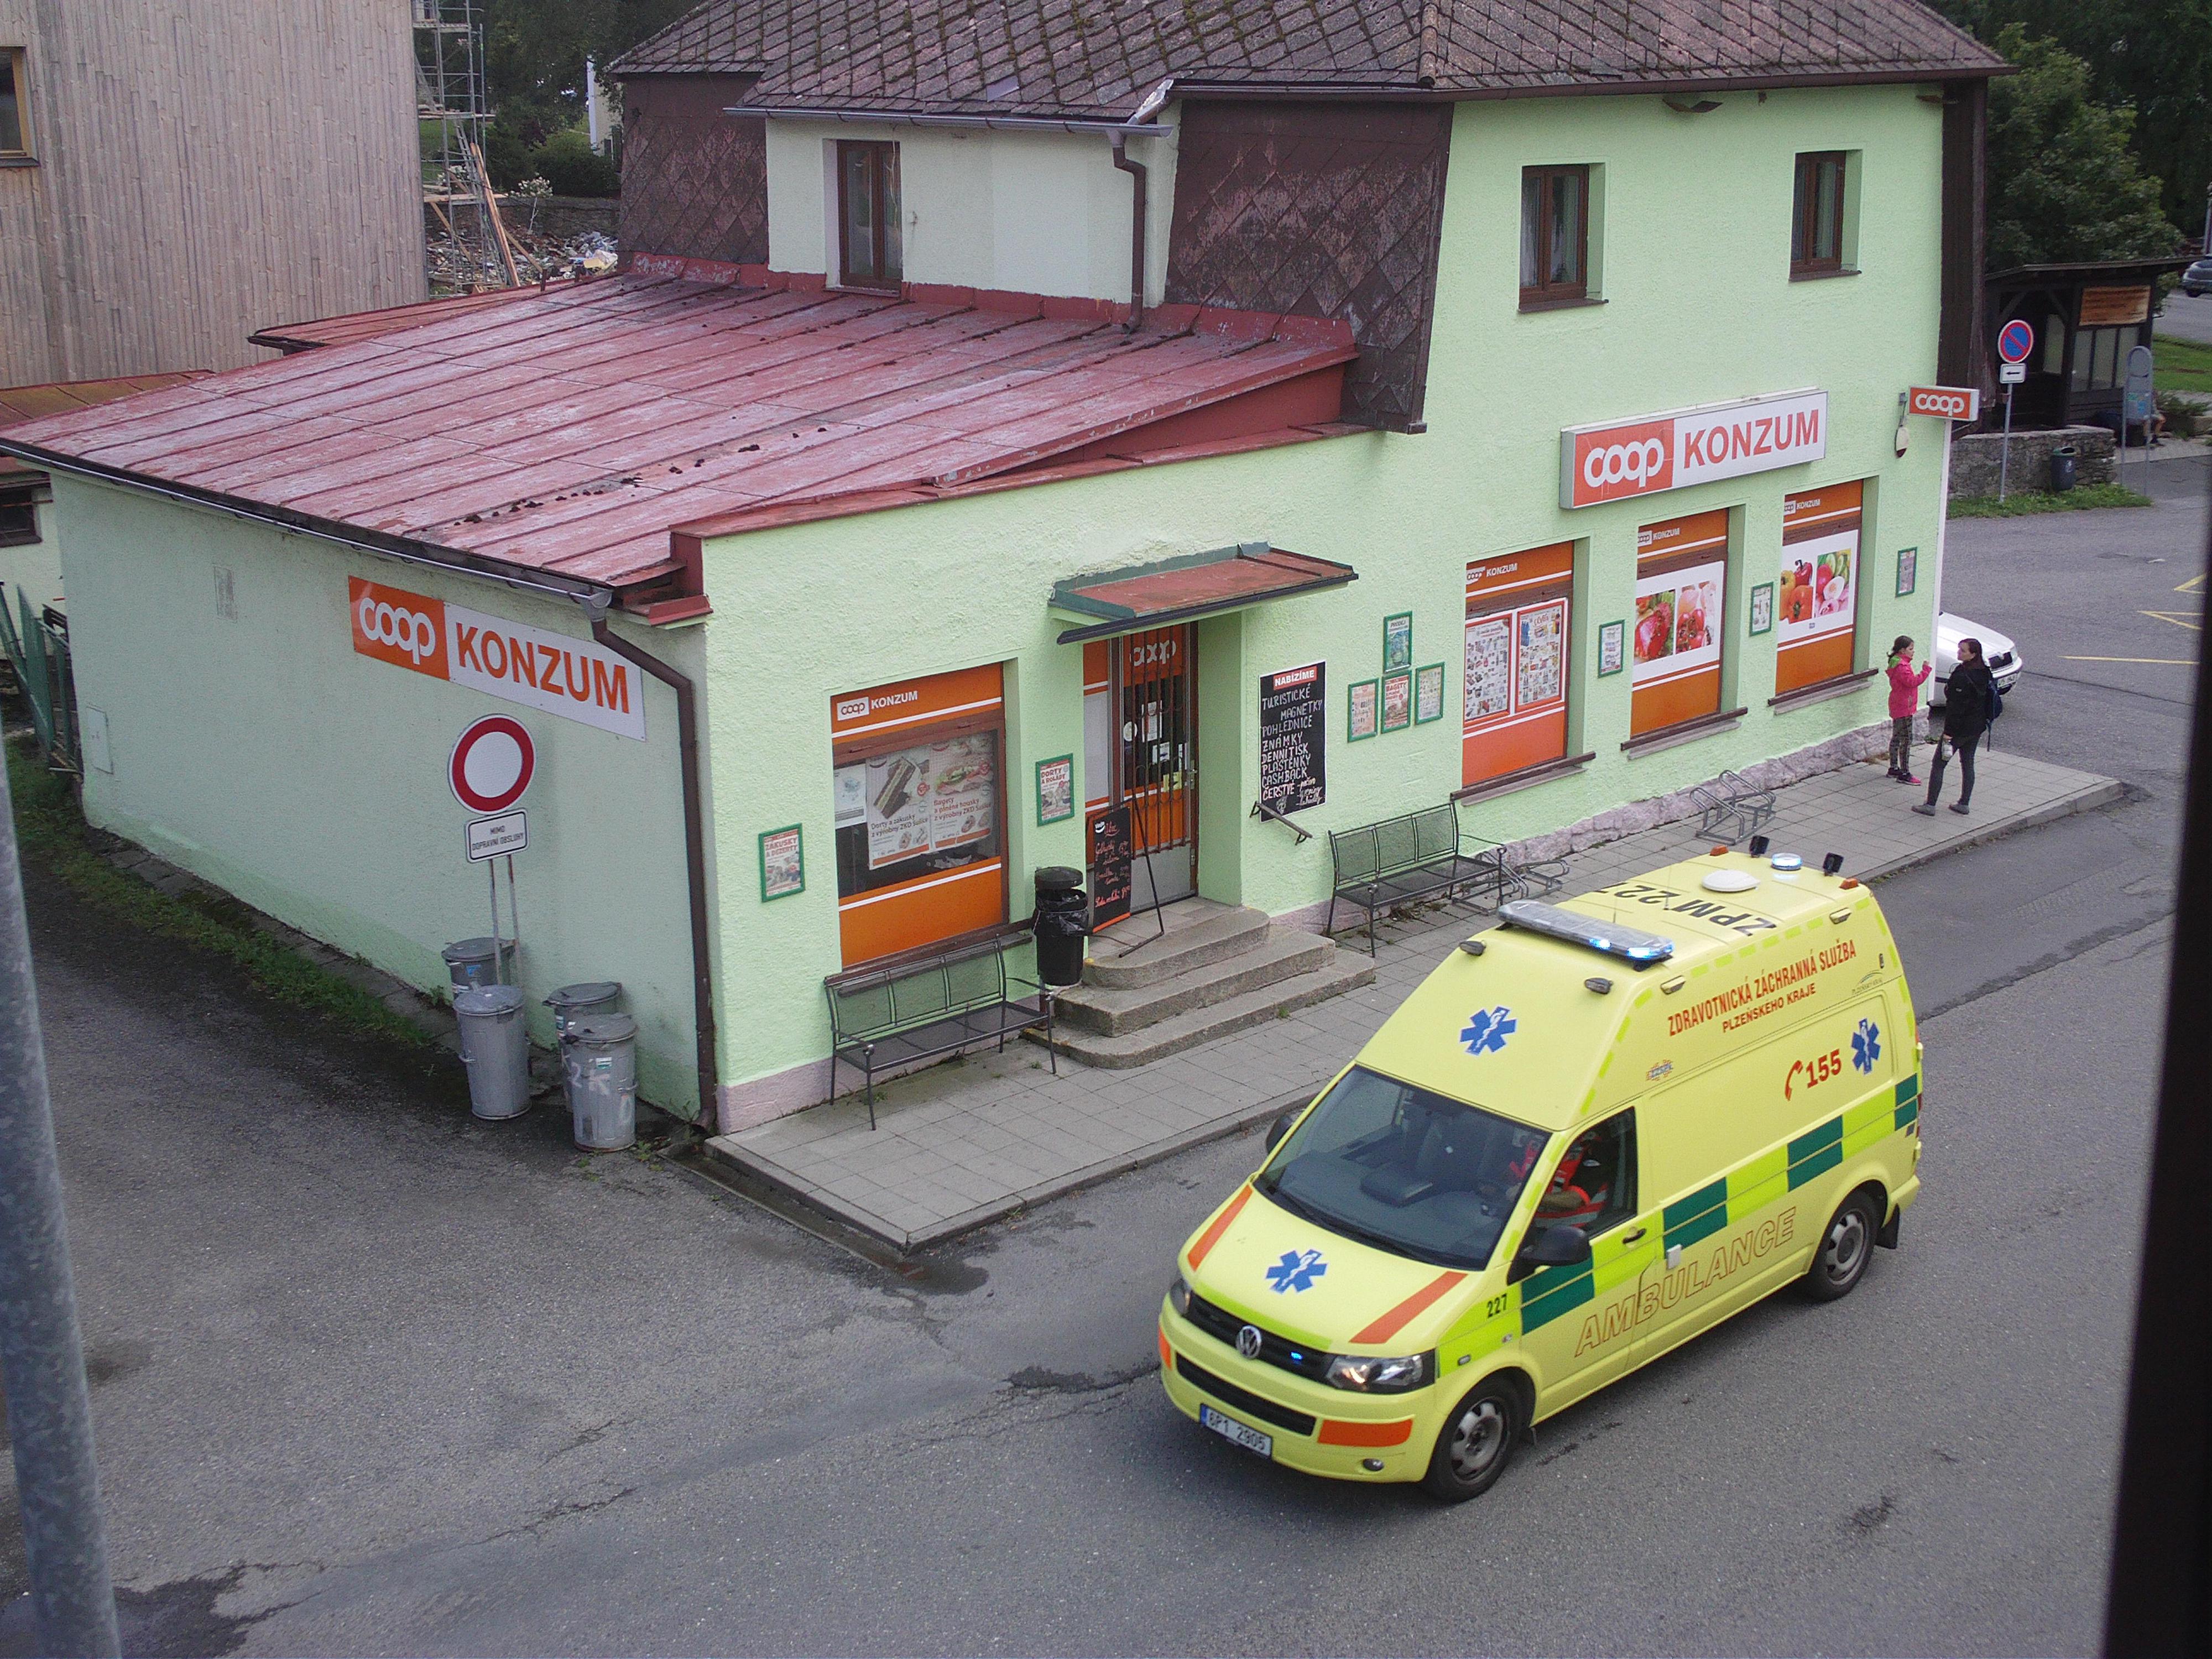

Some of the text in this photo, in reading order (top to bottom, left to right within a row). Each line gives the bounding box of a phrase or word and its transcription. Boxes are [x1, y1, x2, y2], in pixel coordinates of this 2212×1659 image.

[1915, 394, 1964, 417] coop
[1584, 409, 1819, 488] coop KONZUM
[1797, 499, 1820, 509] KONZUM
[1653, 528, 1680, 540] KONZUM
[1486, 563, 1518, 577] KONZUM
[359, 598, 630, 714] coop KONZUM
[1275, 669, 1314, 687] NABÍZÍME
[841, 691, 917, 714] coop KONZUM
[1262, 683, 1311, 710] TURISTICKÉ
[1281, 700, 1322, 721] MAGNETKY
[1262, 715, 1313, 737] POHLEDNICE
[1262, 732, 1303, 752] ZNÁMKY
[1041, 768, 1062, 778] DORTY
[1262, 767, 1307, 788] CASHBACK
[1262, 780, 1295, 801] ČERSTVÉ
[490, 825, 505, 834] MIMO
[472, 838, 498, 851] DOPRAVNÍ
[1672, 899, 1777, 937] ZPM
[1668, 938, 1856, 1036] ZDRAVOTNICKÁ ZÁCHRANNÁ SLUŽBA
[1723, 996, 1784, 1033] PLZEŇSKÉHO
[1787, 982, 1816, 1005] KRAJE
[1806, 1048, 1841, 1088] 155
[1574, 1206, 1796, 1358] AMBULANCE
[1486, 1293, 1507, 1318] 227
